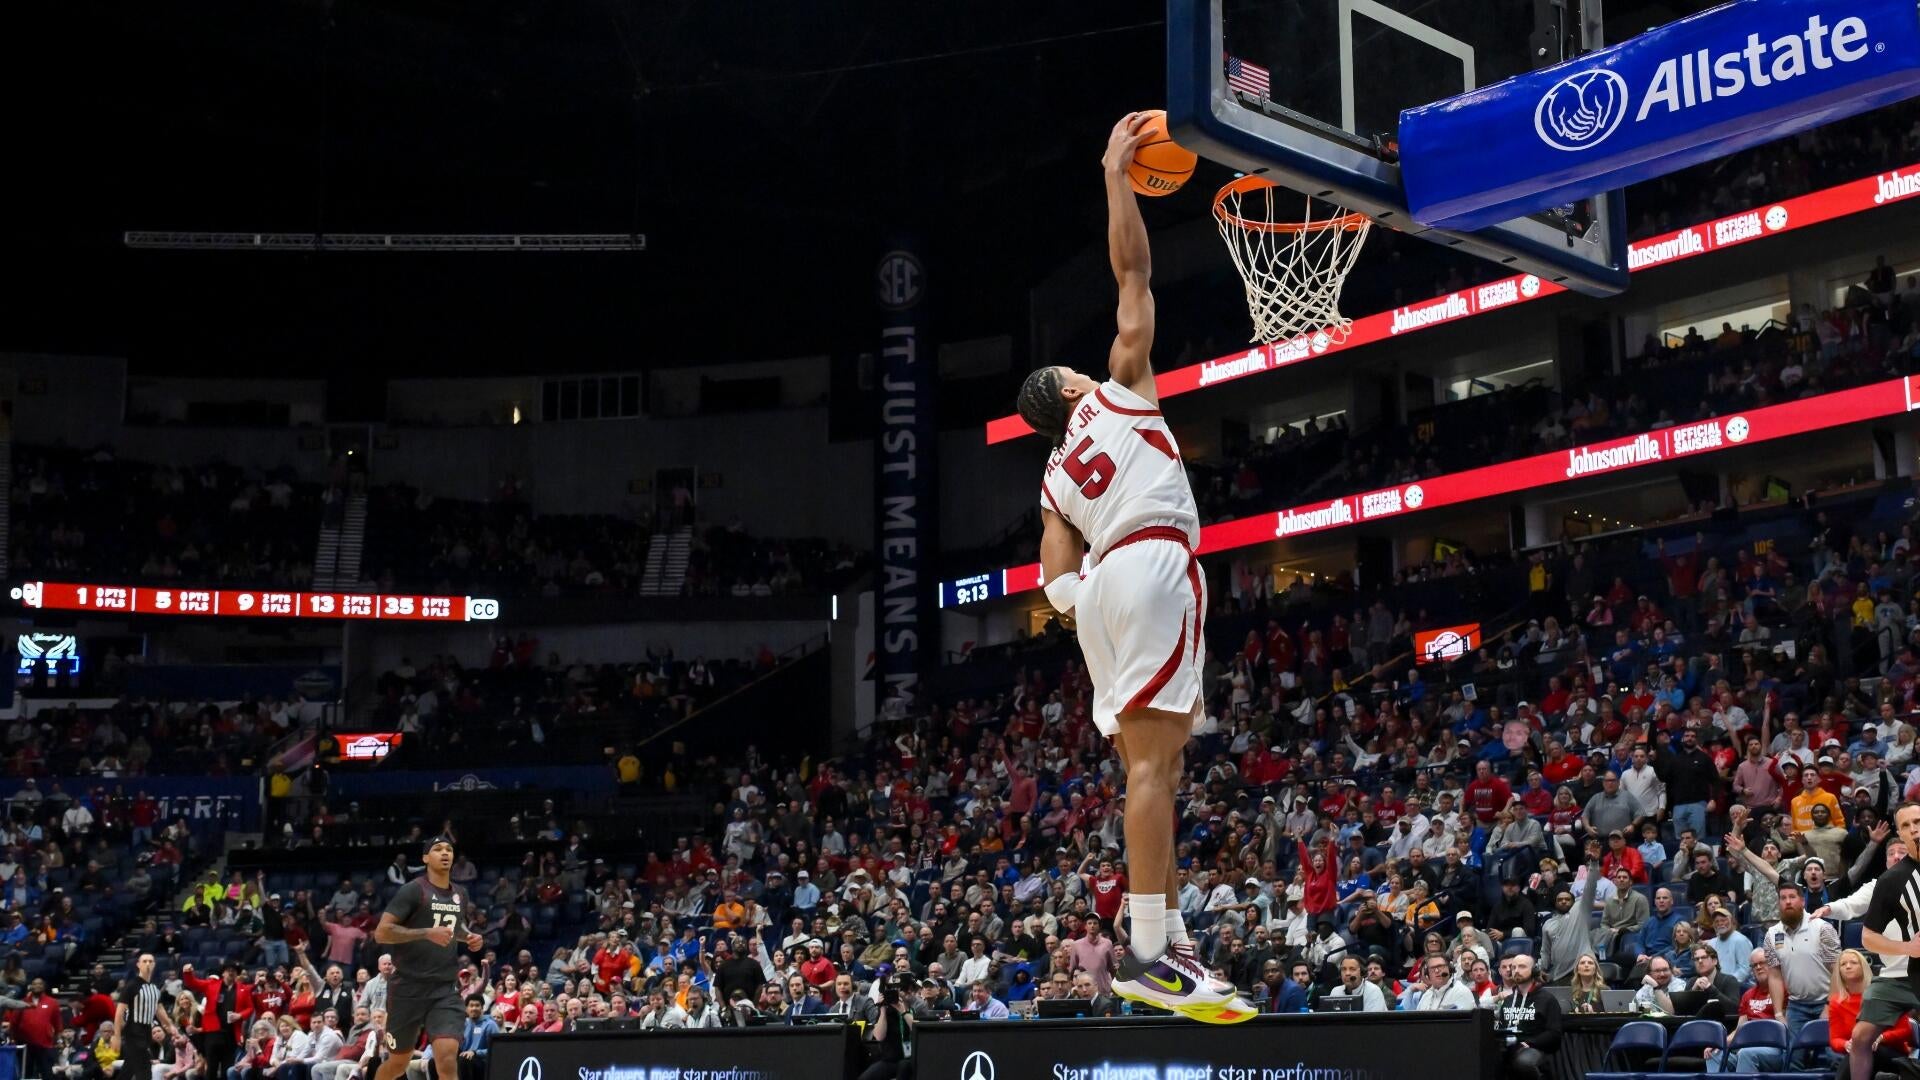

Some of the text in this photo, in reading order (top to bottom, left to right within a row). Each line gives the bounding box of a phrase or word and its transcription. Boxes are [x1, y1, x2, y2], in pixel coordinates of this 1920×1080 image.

[1636, 15, 1869, 122] Allstate
[1716, 212, 1760, 235] OFFICIAL
[1717, 222, 1762, 245] SAUSAGE
[879, 258, 919, 304] SEC
[1391, 293, 1468, 333] Johnsonville
[883, 326, 916, 364] IT
[1199, 349, 1266, 386] Johnsonville
[1078, 403, 1100, 429] JR.
[883, 374, 916, 480] JUST
[1674, 422, 1721, 443] OFFICIAL
[1675, 434, 1722, 454] SAUSAGE
[1567, 434, 1662, 478] Johnsonville
[1061, 435, 1116, 500] 5
[1276, 499, 1353, 536] Johnsonville
[884, 496, 918, 653] MEANS
[77, 588, 87, 604] 1
[105, 589, 126, 598] PTS
[156, 592, 171, 608] 5
[189, 592, 209, 601] PTS
[271, 594, 291, 603] PTS
[351, 597, 371, 606] PTS
[957, 584, 988, 604] 9:13
[105, 598, 126, 607] FLS
[189, 602, 208, 611] FLS
[238, 594, 254, 610] 9
[271, 604, 290, 613] FLS
[310, 596, 334, 612] 13
[385, 598, 414, 614] 35
[431, 598, 450, 607] PTS
[473, 603, 495, 616] CC
[351, 606, 371, 615] FLS
[431, 608, 450, 617] FLS
[431, 903, 460, 912] SOONERS
[578, 1066, 602, 1080] Star
[650, 1067, 681, 1080] meet
[684, 1068, 708, 1080] star
[1053, 1063, 1088, 1080] Star
[1166, 1064, 1213, 1080] meet
[1218, 1064, 1256, 1080] star
